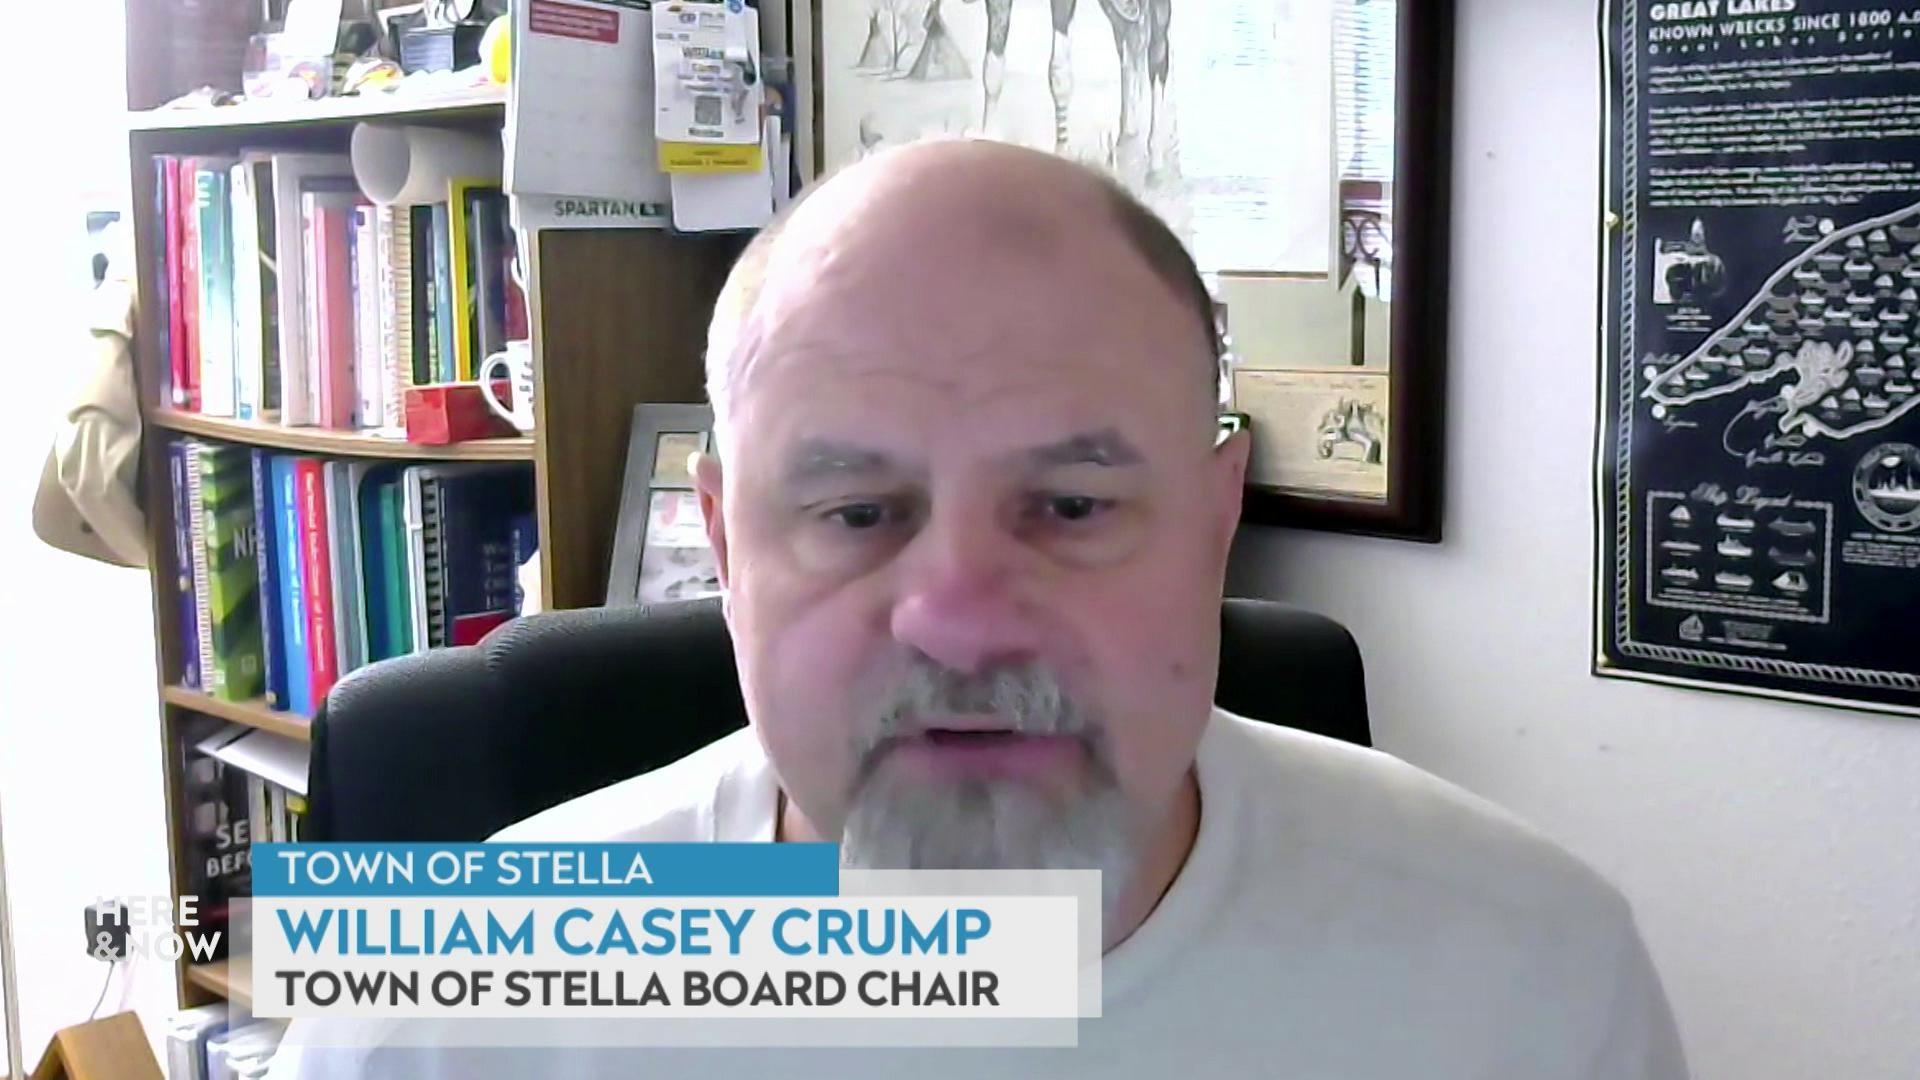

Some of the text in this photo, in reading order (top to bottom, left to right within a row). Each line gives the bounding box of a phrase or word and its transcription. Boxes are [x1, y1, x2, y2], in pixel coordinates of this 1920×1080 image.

[1649, 0, 1719, 21] GREAT
[1648, 24, 1714, 41] KNOWN
[1720, 17, 1786, 35] WRECKS
[1792, 12, 1840, 31] SINCE
[1849, 9, 1892, 28] 1800
[554, 200, 636, 217] SPARTAN
